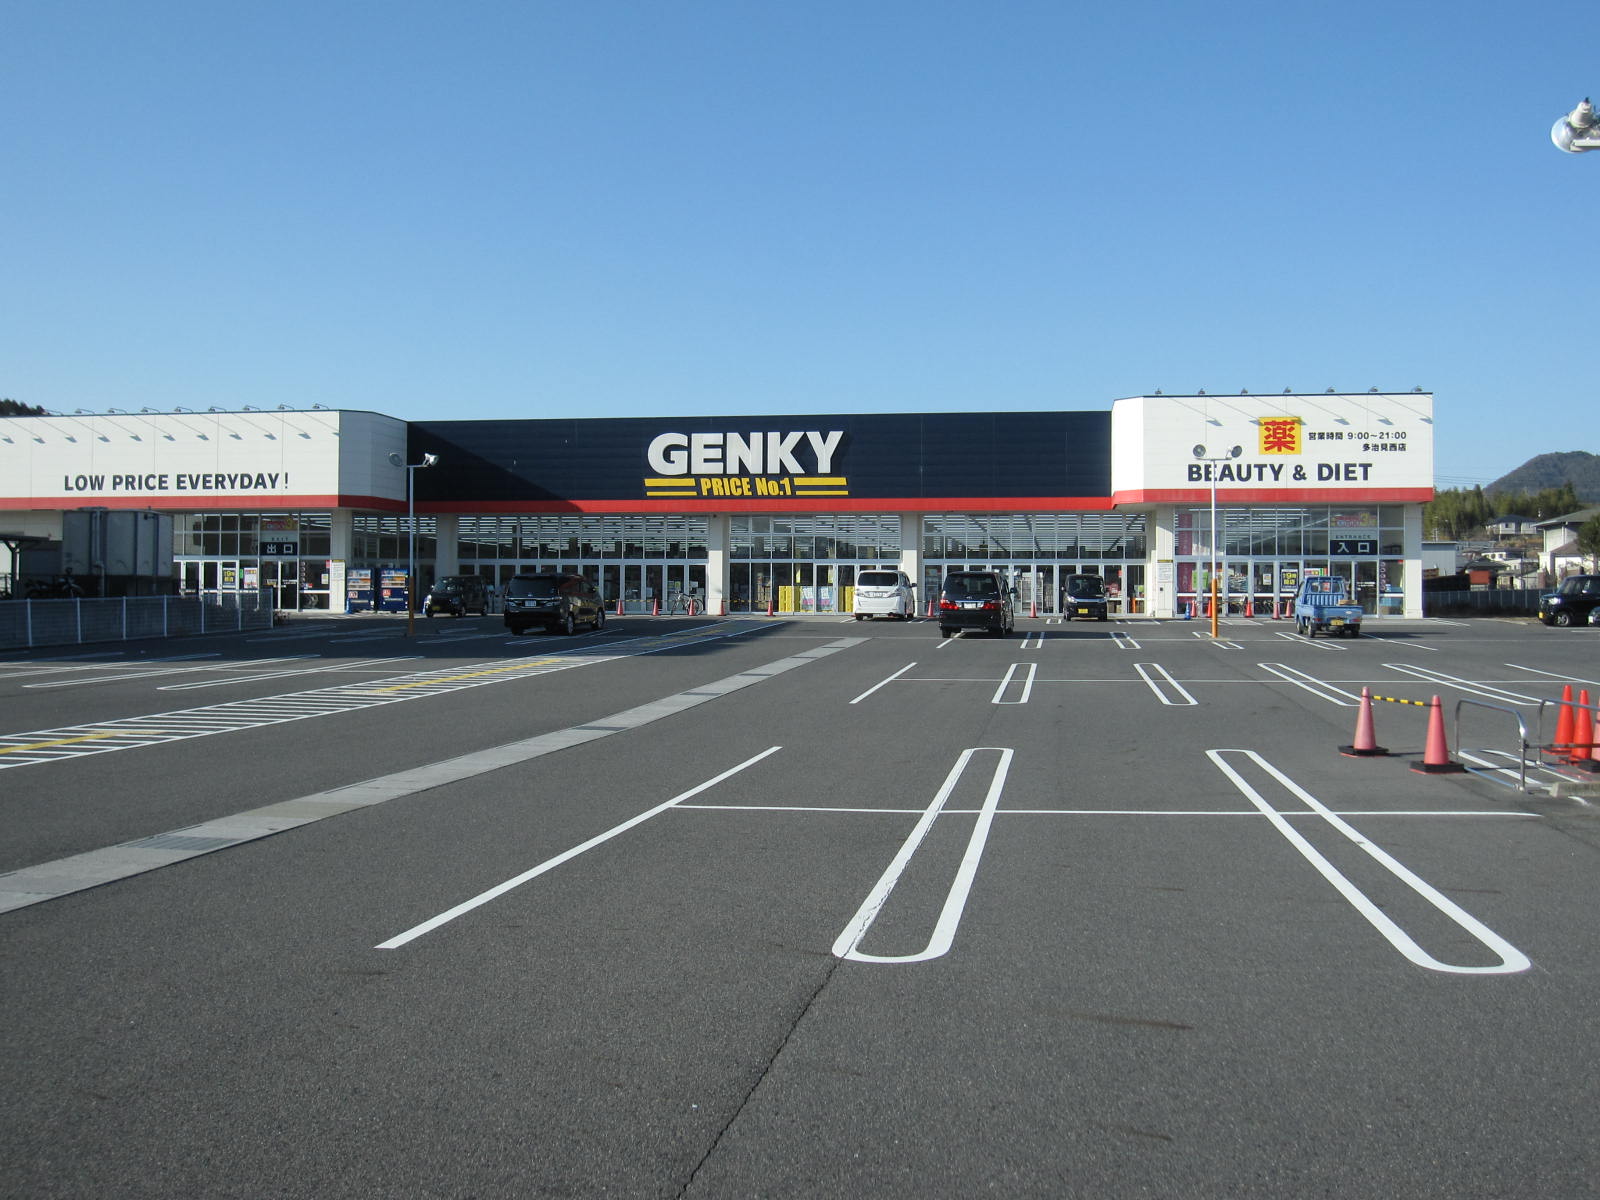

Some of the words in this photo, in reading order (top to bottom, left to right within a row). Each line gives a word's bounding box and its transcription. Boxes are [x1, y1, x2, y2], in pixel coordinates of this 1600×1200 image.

[1263, 420, 1296, 452] 薬
[1308, 431, 1344, 441] 営業時間
[647, 431, 844, 476] GENKY
[1362, 443, 1407, 452] 多治見西店
[1187, 463, 1284, 482] BEAUTY
[1292, 464, 1307, 482] &
[1317, 463, 1373, 482] DIET
[64, 475, 105, 492] LOW
[112, 473, 169, 491] PRICE
[700, 477, 753, 497] PRICE
[755, 477, 792, 496] No.1
[266, 544, 293, 555] 出口
[1337, 542, 1370, 553] 入口
